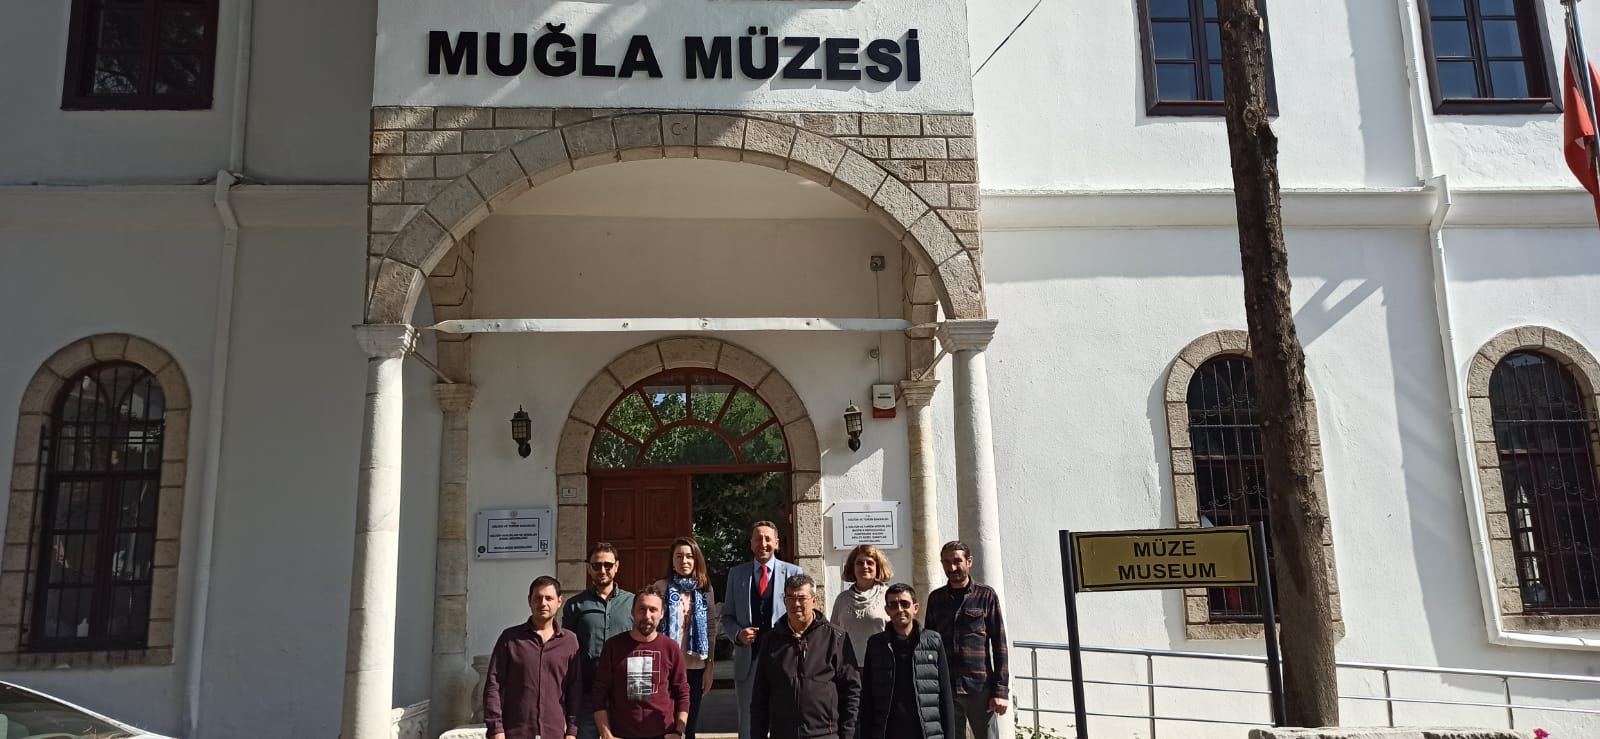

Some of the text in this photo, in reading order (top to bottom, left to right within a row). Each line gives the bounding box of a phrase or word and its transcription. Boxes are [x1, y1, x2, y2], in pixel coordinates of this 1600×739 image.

[427, 23, 921, 82] MUĞLA MÜZESİ
[1133, 538, 1197, 558] MÜZE
[1117, 562, 1217, 581] MUSEUM
